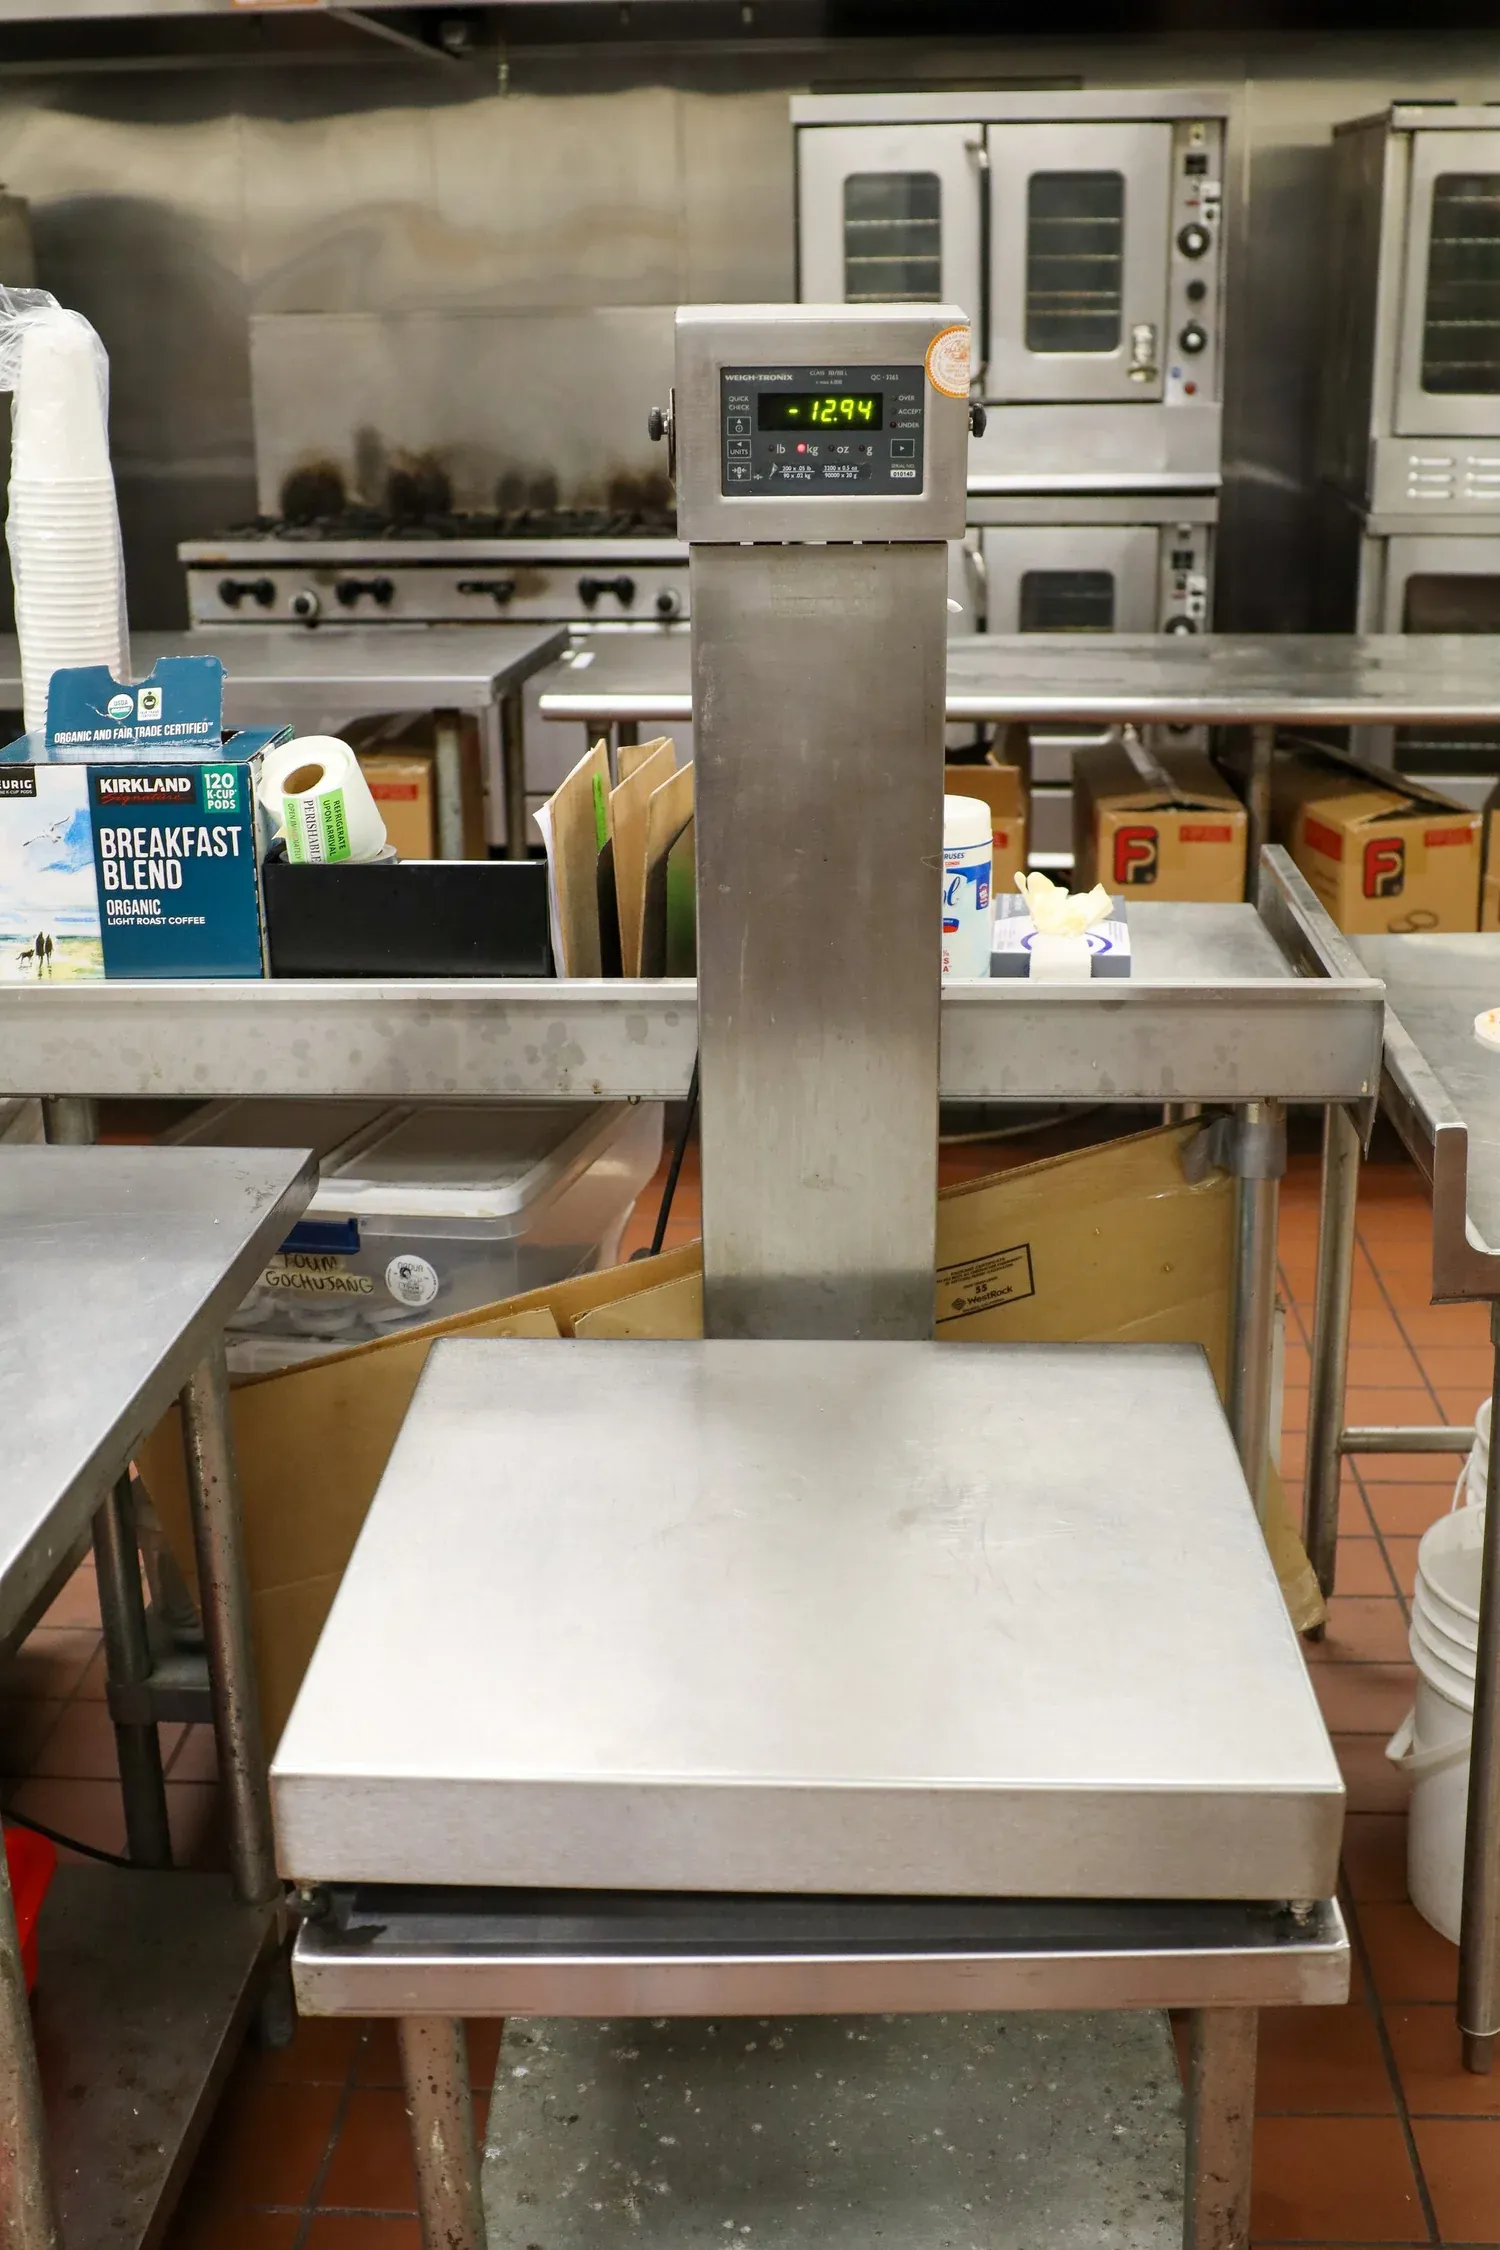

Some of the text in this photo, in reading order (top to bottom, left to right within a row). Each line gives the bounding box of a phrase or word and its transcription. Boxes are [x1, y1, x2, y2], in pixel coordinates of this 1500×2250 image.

[811, 399, 872, 422] 12.94
[776, 444, 786, 454] lb
[806, 444, 819, 456] kg
[836, 446, 849, 454] oz
[866, 446, 873, 456] g
[54, 731, 92, 744] ORGANIC
[93, 729, 112, 741] AND
[113, 726, 133, 739] FAIR
[134, 725, 163, 738] TRADE
[0, 780, 33, 789] URIG
[100, 777, 191, 793] KIRKLAND
[204, 773, 235, 789] 120
[208, 800, 236, 809] PODS
[287, 803, 296, 820] OPEN
[303, 800, 322, 863] PERISHABLE
[323, 800, 337, 857] UPON ARRIVAL
[333, 800, 346, 850] REFRIGERATE
[100, 826, 242, 859] BREAKFAST
[102, 859, 183, 890] BLEND
[106, 899, 161, 916] ORGANIC
[136, 917, 166, 925] ROAST
[168, 917, 206, 925] COFFEE
[265, 1270, 375, 1294] GOCHUJANG
[967, 1286, 1013, 1304] WestRock
